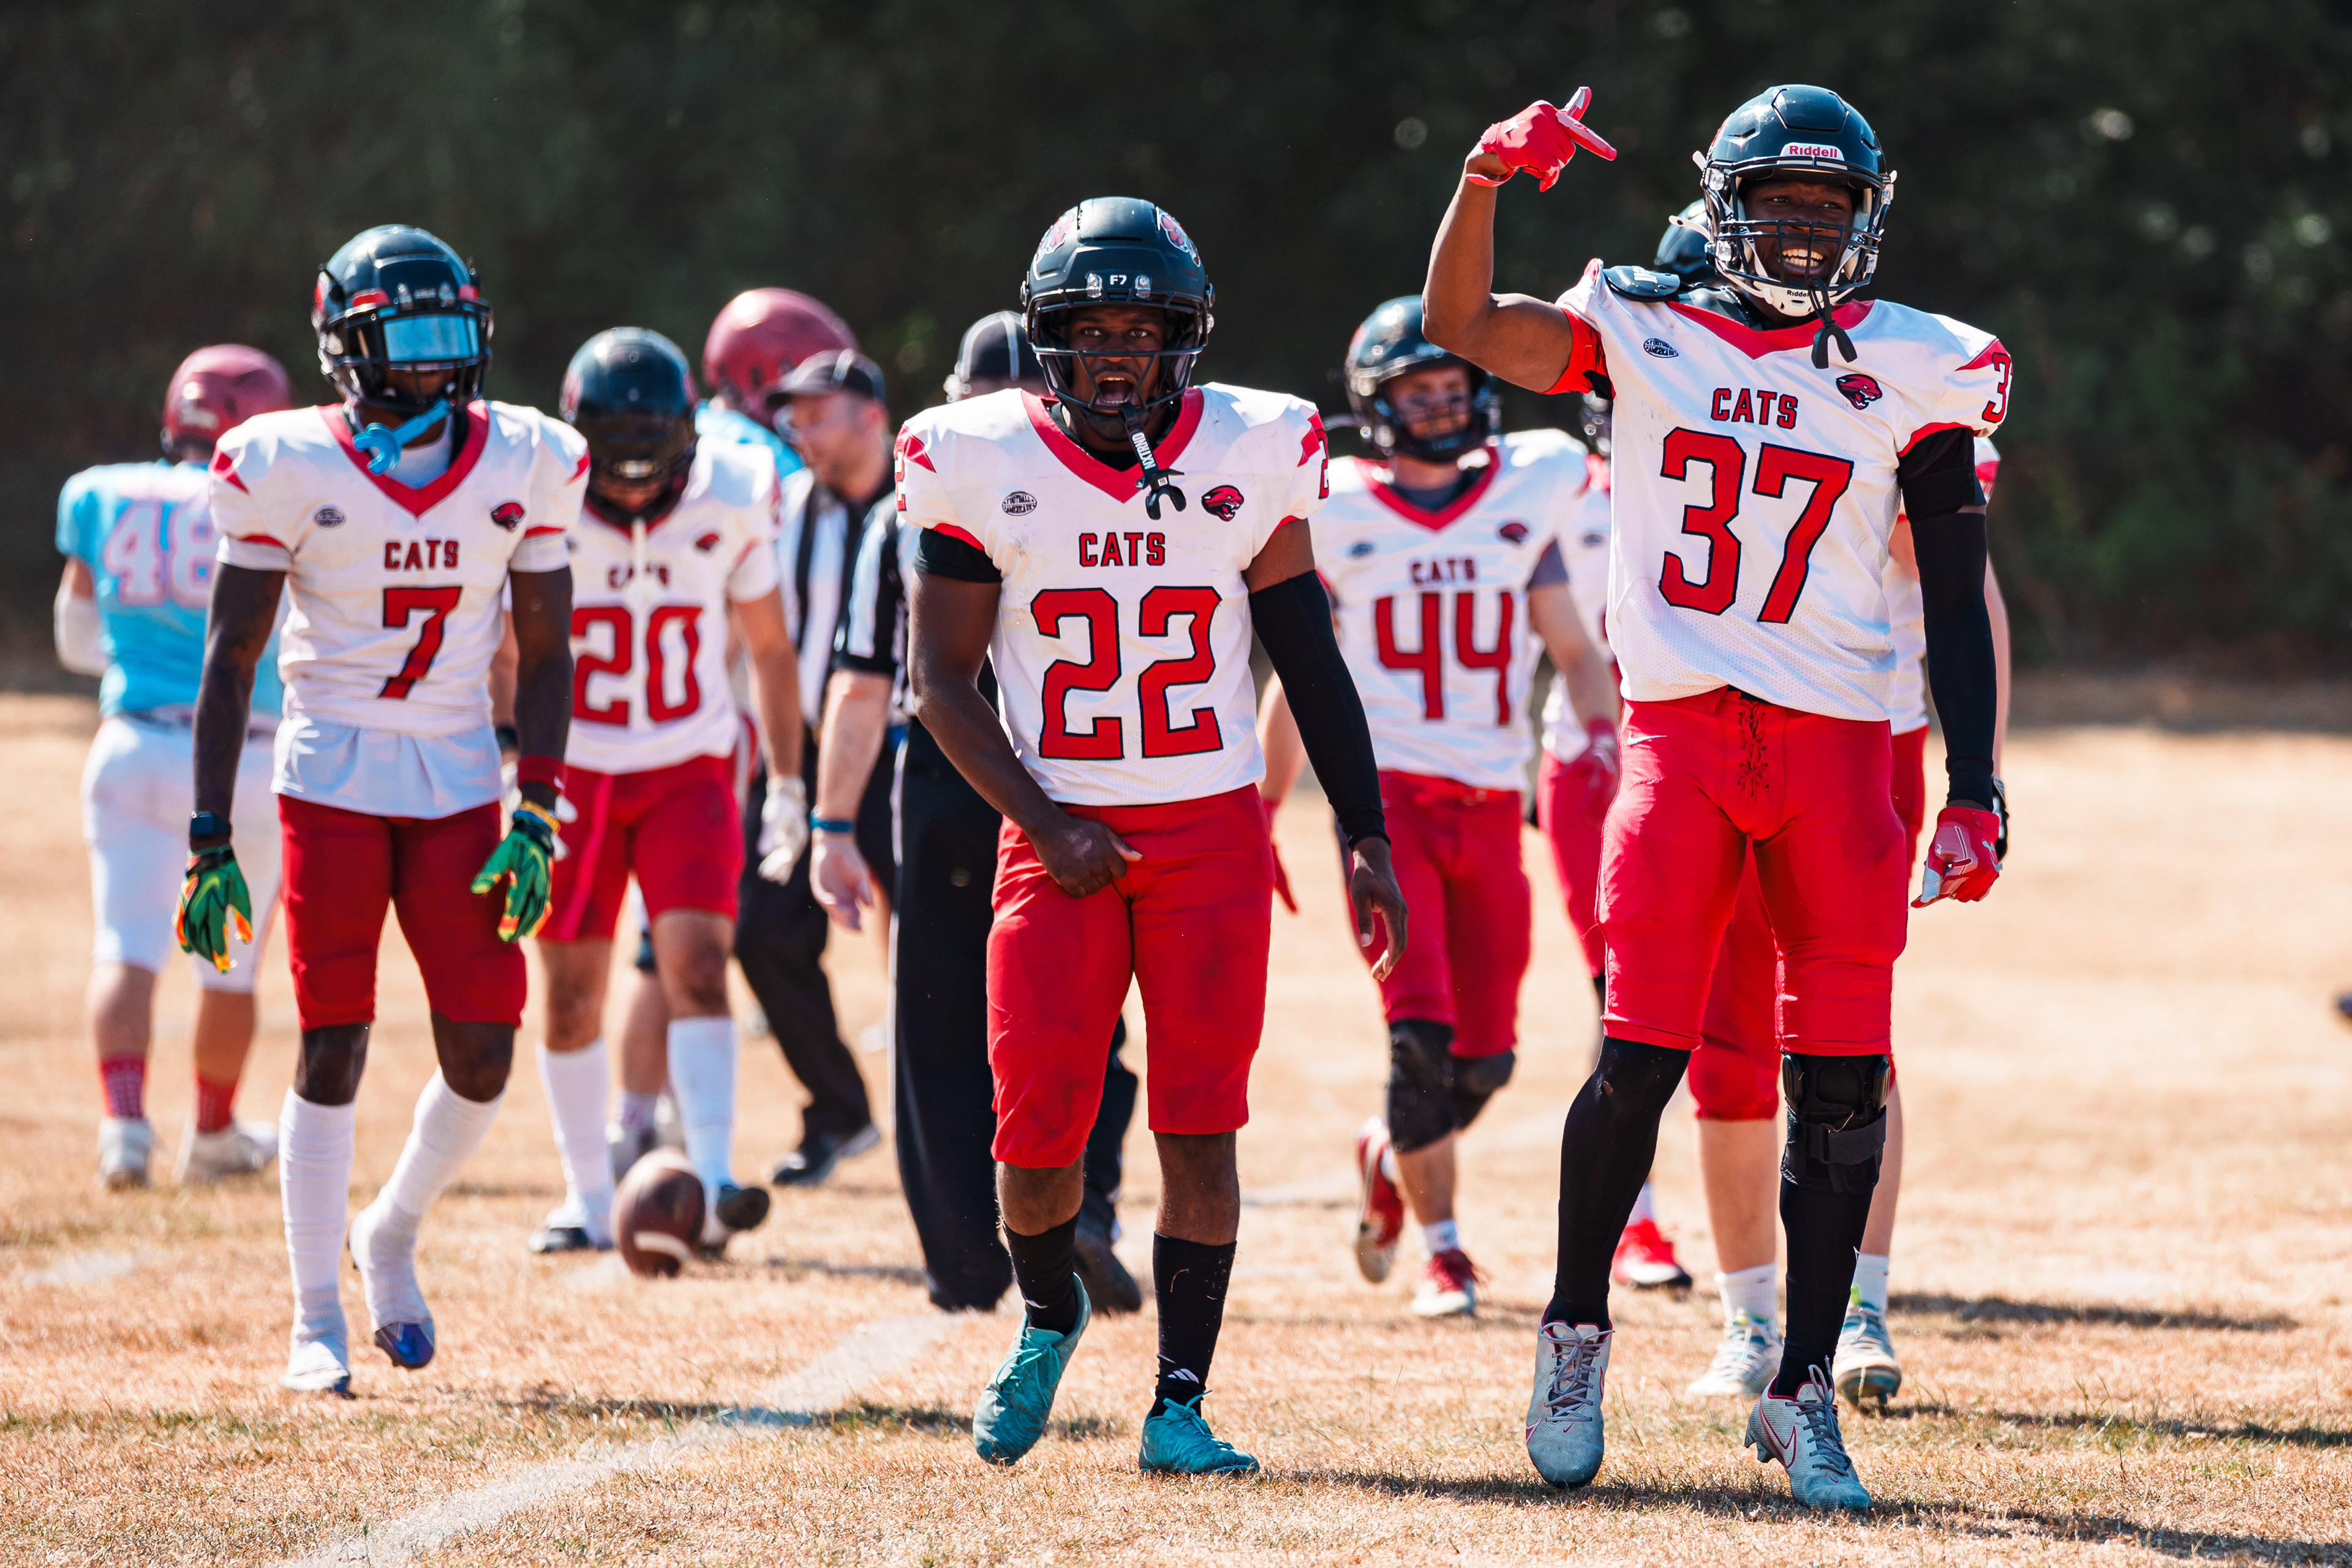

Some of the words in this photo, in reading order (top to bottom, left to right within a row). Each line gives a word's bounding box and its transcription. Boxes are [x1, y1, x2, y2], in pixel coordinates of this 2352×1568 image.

[1789, 145, 1838, 158] Riddell
[1110, 274, 1127, 285] F7
[1711, 388, 1798, 429] CATS
[1131, 431, 1156, 470] NXTRND
[1658, 427, 1855, 624] 37
[101, 501, 216, 608] 48
[384, 539, 459, 570] CATS
[1079, 532, 1166, 567] CATS
[1410, 557, 1477, 586] CATS
[377, 586, 463, 700] 7
[1374, 591, 1514, 727] 44
[571, 604, 704, 725] 20
[1030, 586, 1223, 760] 22
